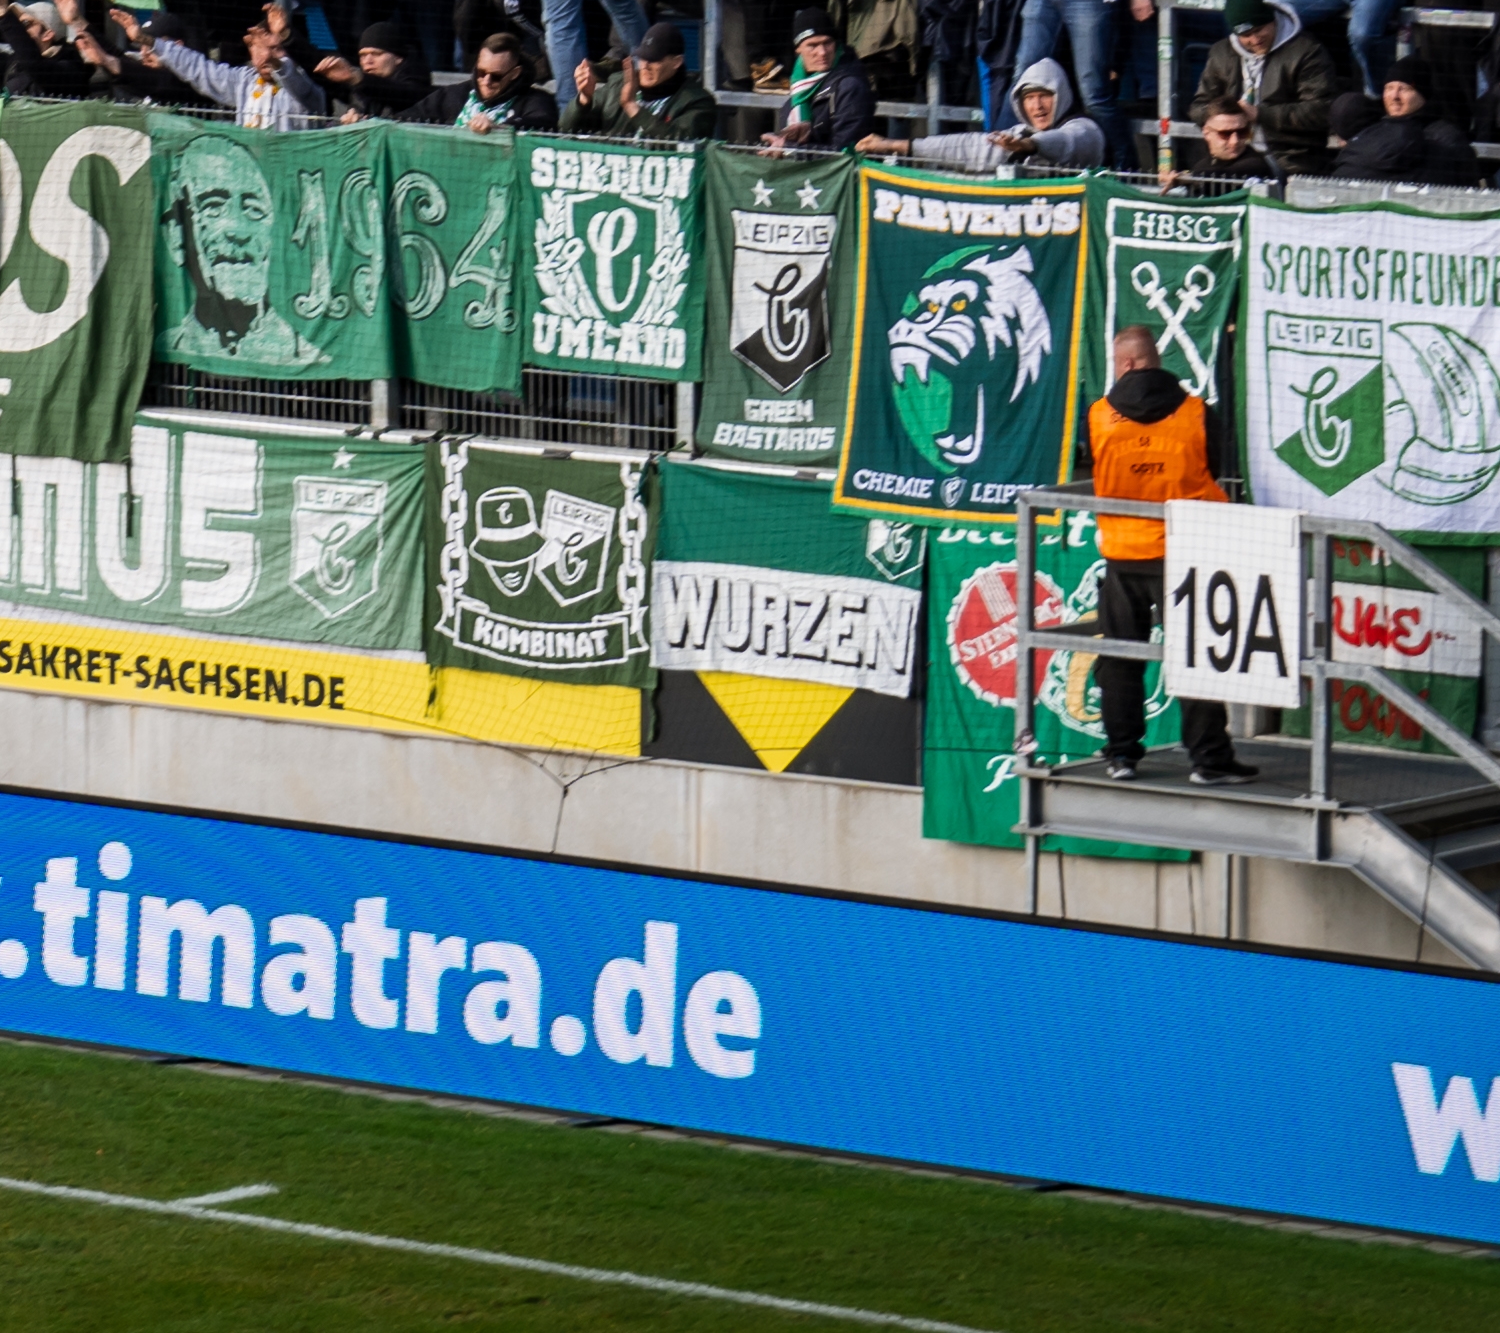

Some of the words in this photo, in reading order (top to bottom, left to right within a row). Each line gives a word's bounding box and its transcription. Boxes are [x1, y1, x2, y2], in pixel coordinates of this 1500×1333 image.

[530, 146, 696, 200] SEKTION
[742, 219, 831, 245] LEIPZIG
[873, 187, 1082, 237] PARVENÜS
[1132, 211, 1221, 244] HBSG
[290, 166, 521, 334] 1964
[540, 238, 588, 274] 19
[647, 246, 690, 281] 64
[531, 311, 687, 370] UMLAND
[1275, 322, 1373, 350] LEIPZIG
[743, 398, 814, 423] GREEN
[711, 422, 838, 452] BASTARDS
[303, 484, 378, 509] LEIPZIG
[852, 467, 933, 500] CHEMIE
[969, 481, 1046, 504] LEIP
[552, 499, 607, 529] LEIPZIG
[472, 615, 608, 660] KOMBINAT
[662, 573, 922, 677] WURZEN
[1172, 566, 1288, 678] 19A
